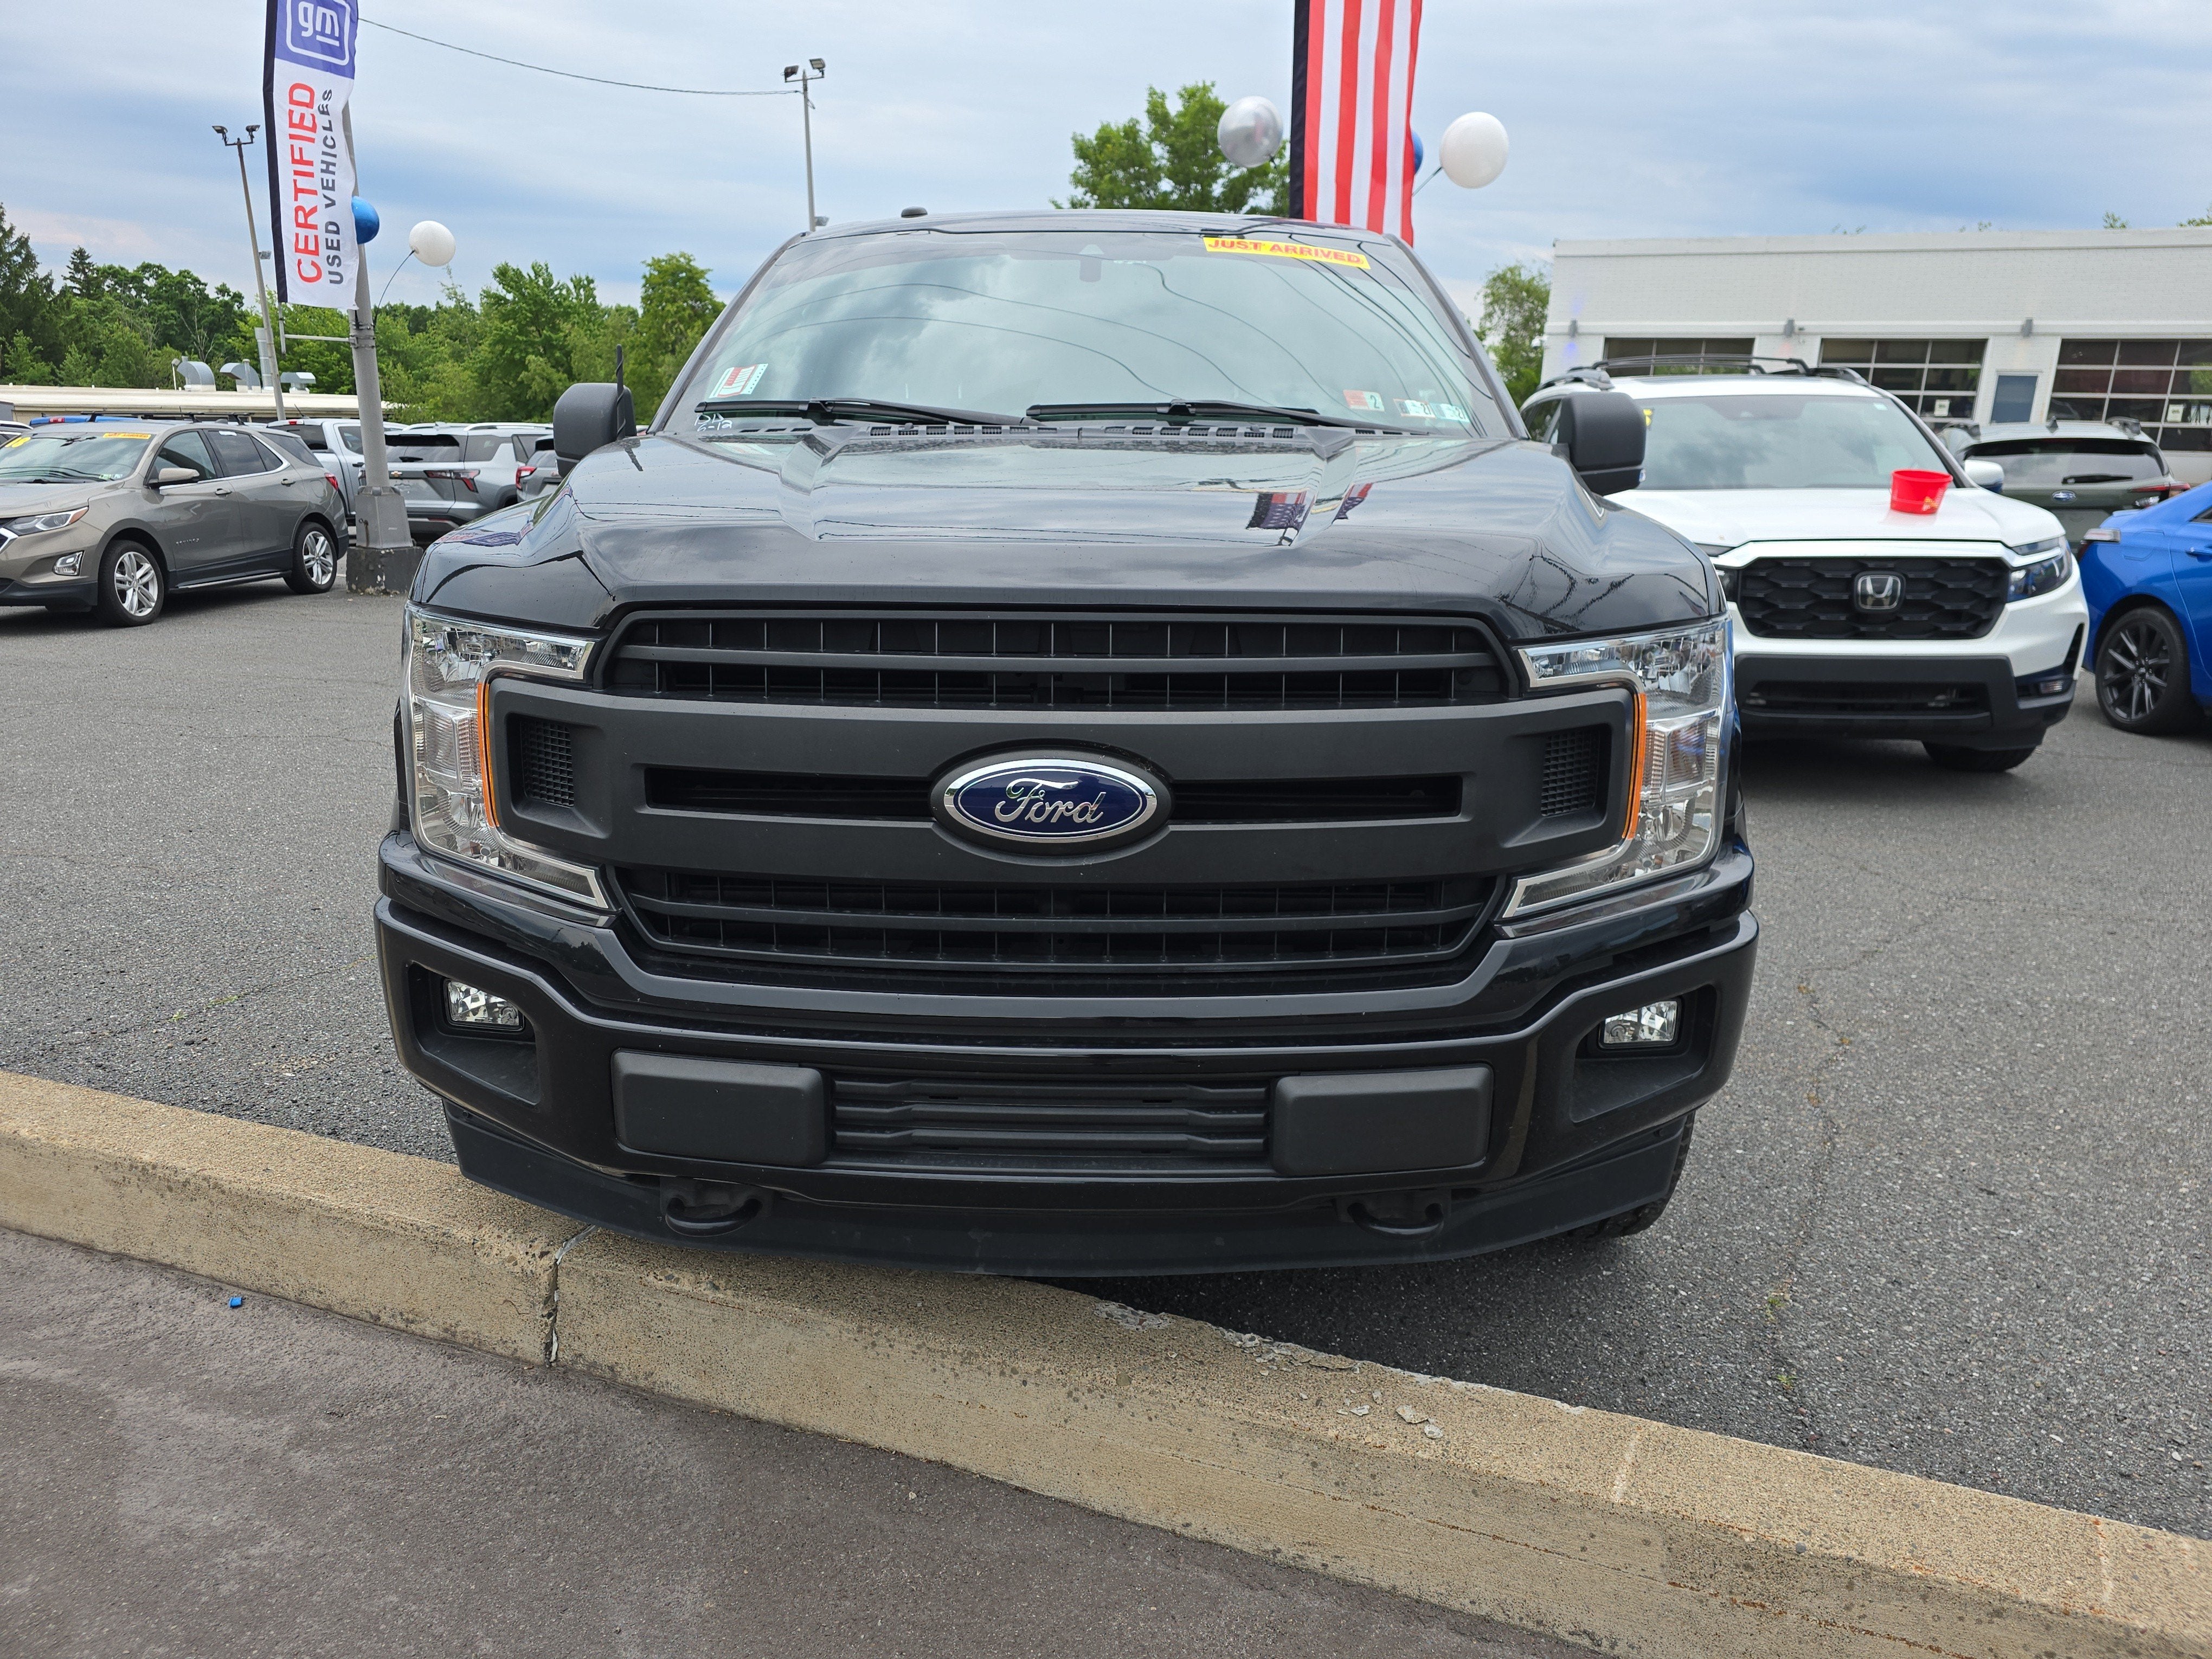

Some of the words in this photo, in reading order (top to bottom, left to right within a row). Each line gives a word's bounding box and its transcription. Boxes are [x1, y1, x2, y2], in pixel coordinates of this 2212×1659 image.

[318, 89, 337, 209] VEHICLES
[288, 82, 323, 283] CERTIFIED
[325, 221, 344, 284] USED
[1209, 239, 1262, 251] JUST
[1270, 243, 1362, 264] ARRIVED
[995, 777, 1106, 824] Ford
